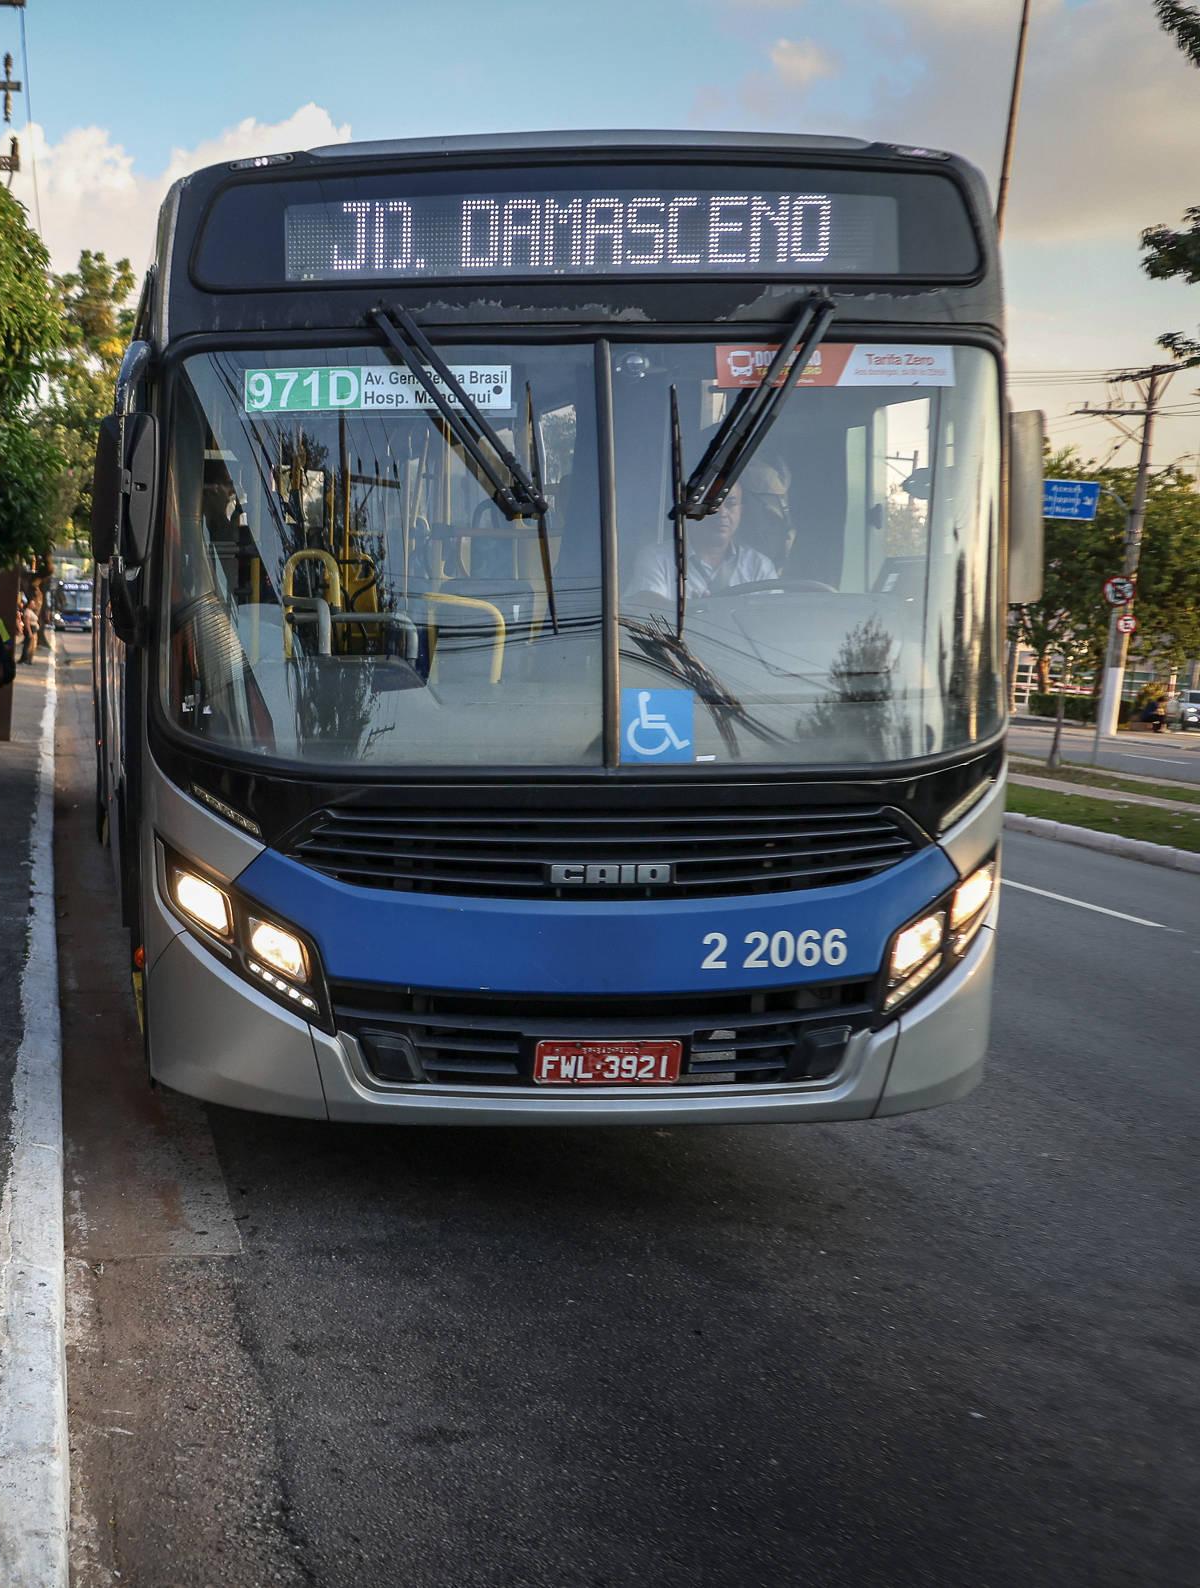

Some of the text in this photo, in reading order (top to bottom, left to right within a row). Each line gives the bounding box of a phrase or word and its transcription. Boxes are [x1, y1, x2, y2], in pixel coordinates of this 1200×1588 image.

[332, 195, 832, 271] JD. DAMASCENO
[864, 352, 935, 366] Tarifa Zero
[248, 367, 359, 409] 971D
[364, 371, 385, 386] Av.
[388, 371, 419, 385] Gen.
[469, 370, 507, 384] Brasil
[364, 389, 491, 407] Hosp. Mandqui
[550, 864, 671, 884] CAIO
[700, 928, 849, 970] 2 2066
